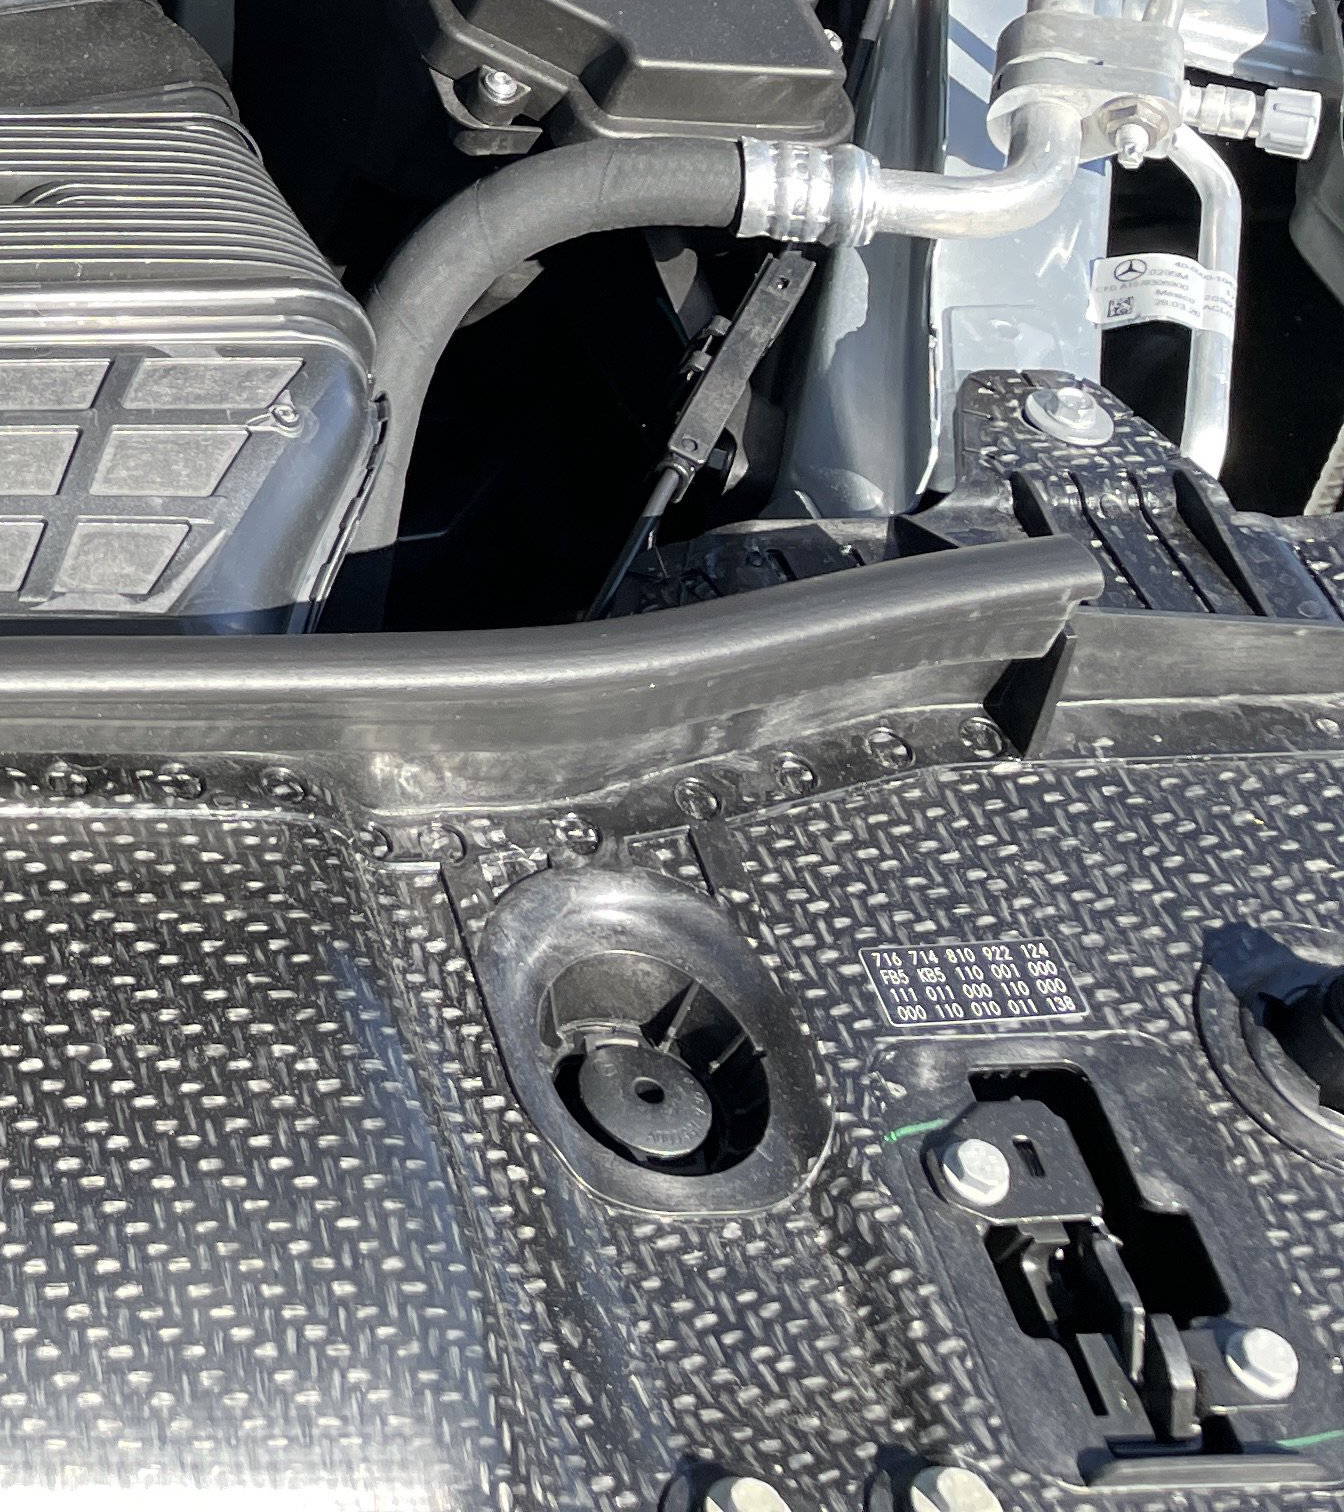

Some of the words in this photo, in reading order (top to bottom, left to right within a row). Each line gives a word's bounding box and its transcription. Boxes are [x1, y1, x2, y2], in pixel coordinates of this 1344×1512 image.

[871, 952, 902, 968] 716
[908, 949, 938, 966] 714
[946, 948, 975, 964] 810
[982, 945, 1013, 962] 922
[1021, 943, 1049, 960] 124
[880, 970, 909, 985] FB5
[917, 967, 946, 983] KB5
[955, 965, 984, 981] 110
[991, 962, 1020, 979] 001
[1028, 960, 1057, 976] 000
[890, 988, 917, 1003] 111
[926, 985, 955, 1001] 011
[962, 982, 992, 999] 000
[1001, 981, 1029, 997] 110
[1036, 978, 1067, 994] 000
[897, 1005, 926, 1021] 000
[936, 1003, 964, 1018] 110
[971, 1000, 1001, 1017] 010
[1008, 999, 1038, 1015] 011
[1046, 996, 1076, 1012] 138
